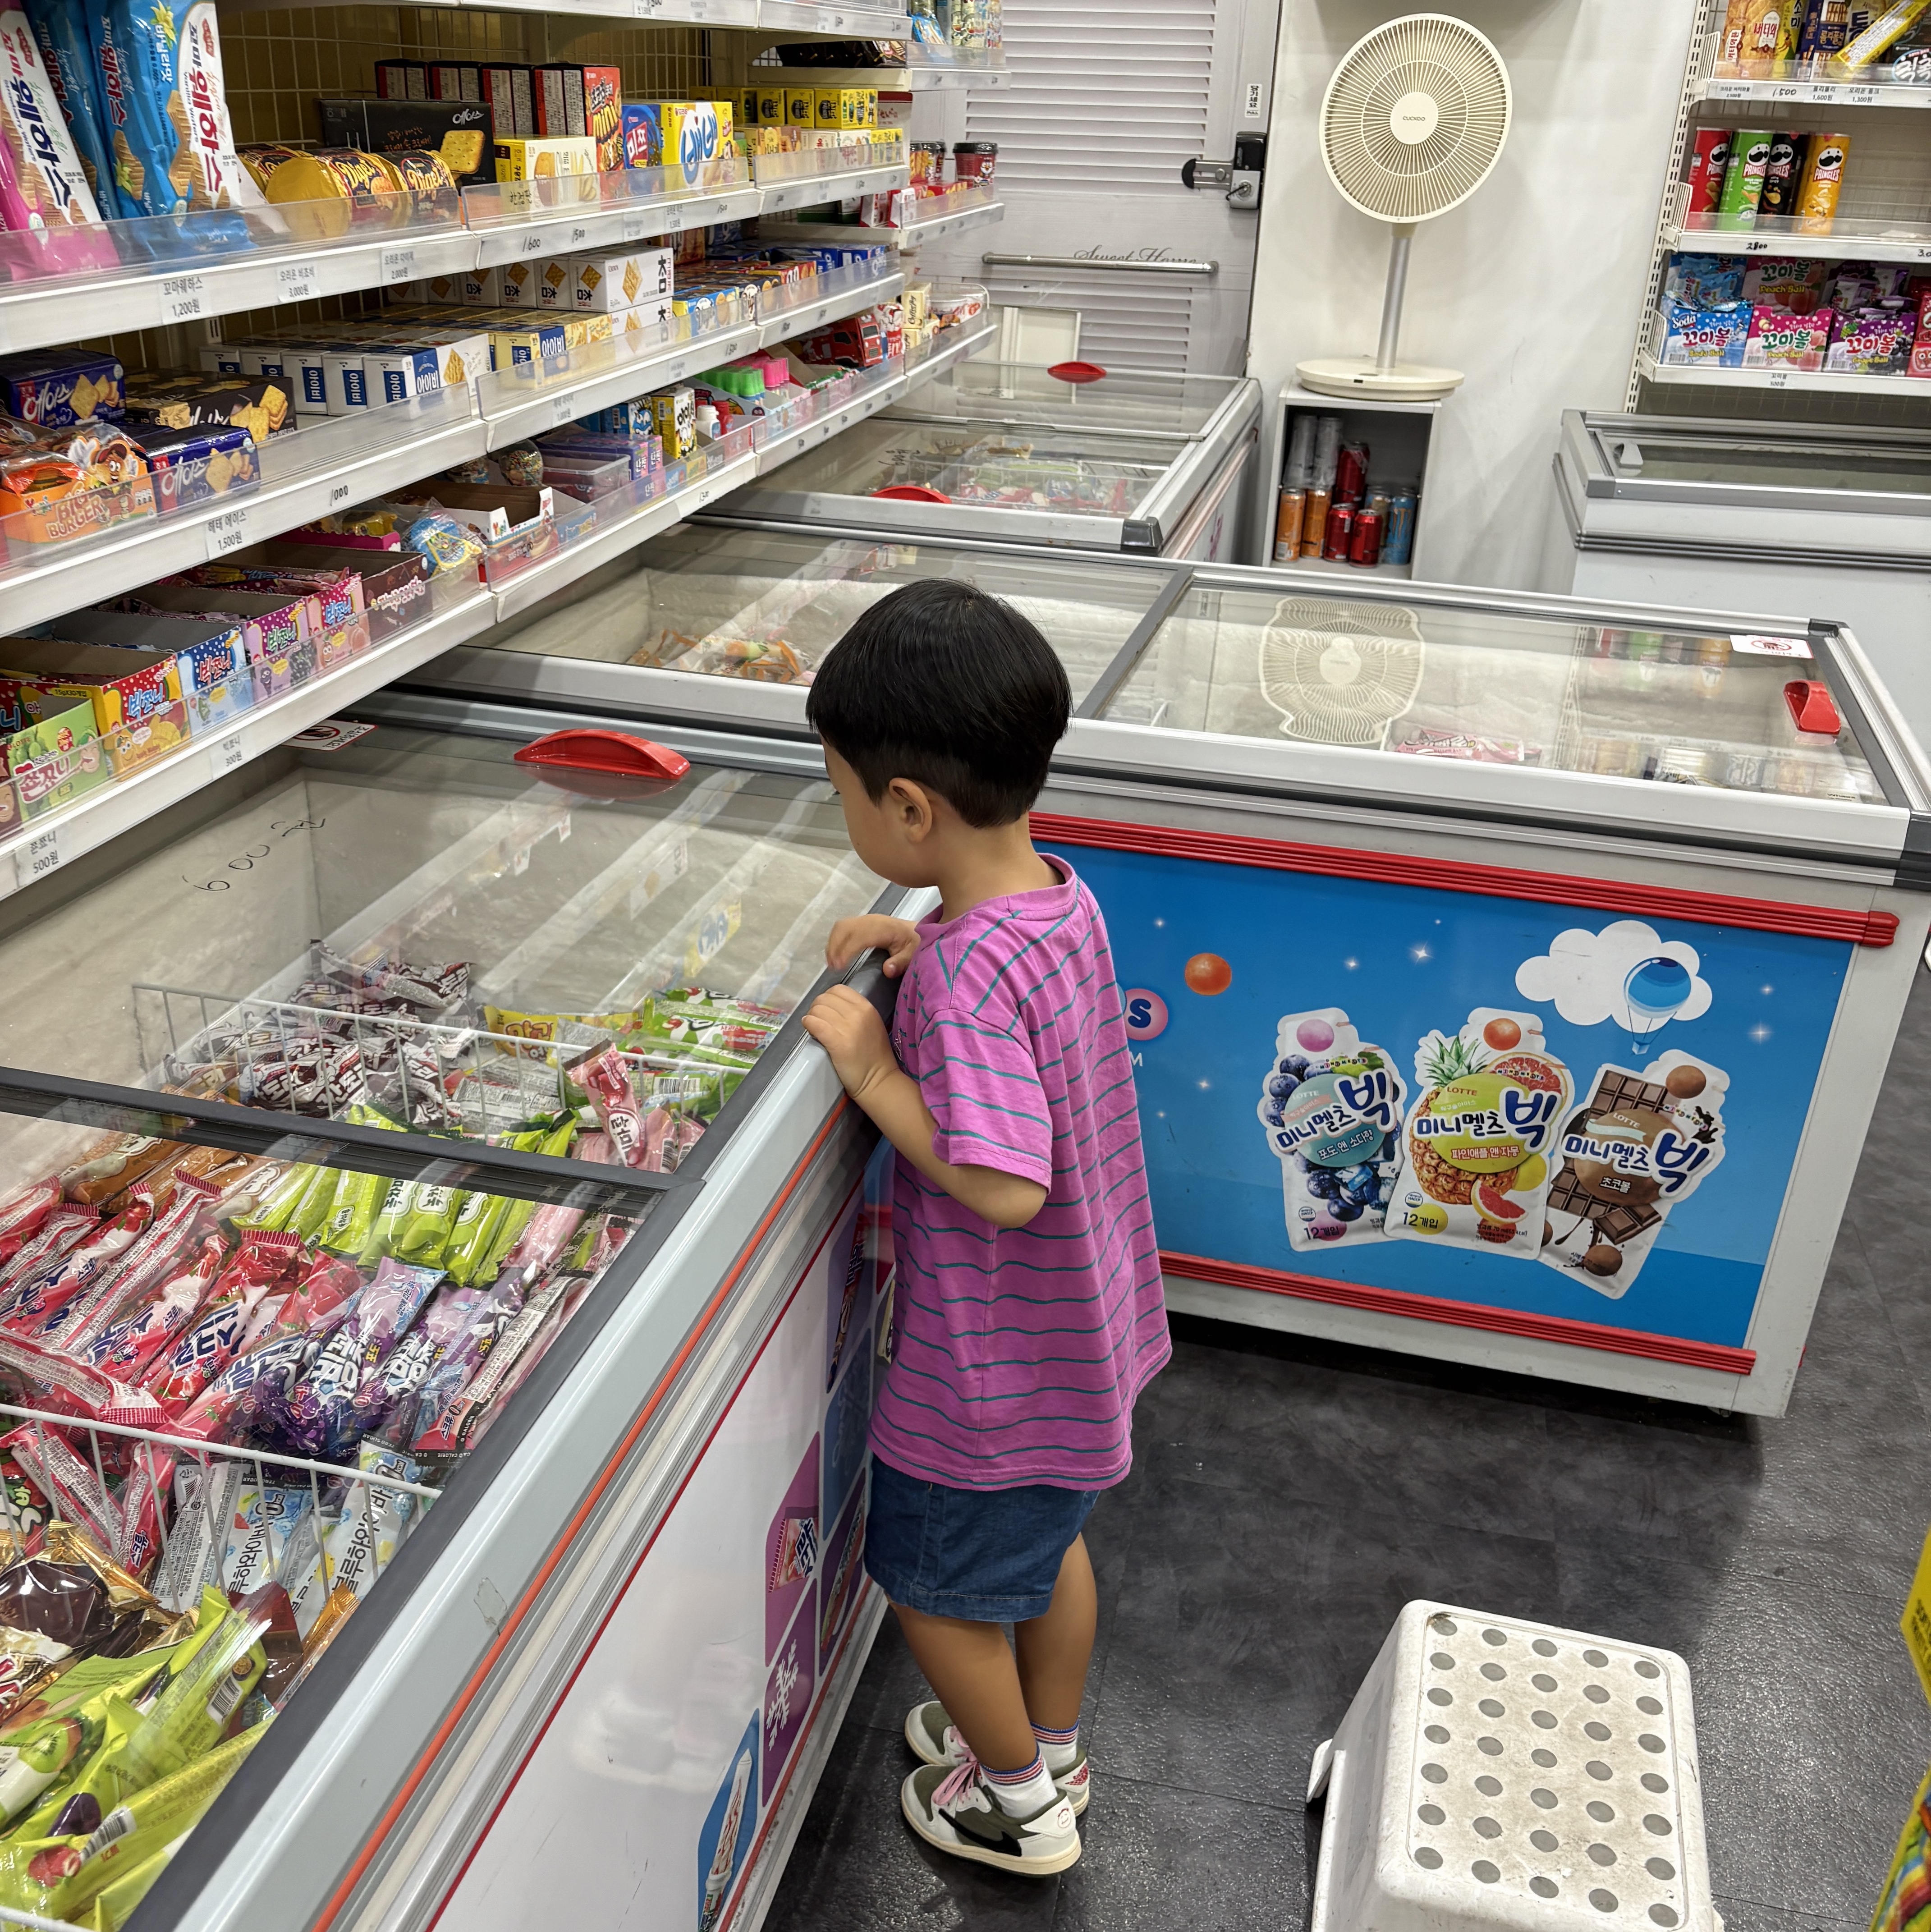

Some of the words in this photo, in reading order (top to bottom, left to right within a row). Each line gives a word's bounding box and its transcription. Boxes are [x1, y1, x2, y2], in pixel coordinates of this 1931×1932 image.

[188, 21, 220, 193] 꼬마웨하스
[1248, 85, 1259, 108] 당기세요
[1812, 94, 1833, 102] 1,600원
[0, 28, 70, 208] 꼬마웨하스
[1814, 168, 1840, 182] PRINGLES
[523, 239, 541, 252] 1600
[1761, 261, 1811, 283] 꼬미볼
[164, 277, 203, 295] 꼬마웨하스
[1759, 285, 1785, 294] Peach
[1788, 285, 1805, 294] Ball
[172, 299, 200, 317] 1,200원
[1672, 315, 1697, 329] Soda
[1683, 327, 1732, 348] 꼬미볼
[1761, 330, 1812, 350] 꼬미볼
[1845, 334, 1896, 355] 꼬미볼
[56, 490, 91, 523] BIG
[46, 496, 105, 539] BURGER
[225, 511, 247, 527] 에이스
[217, 529, 243, 551] 1,500원
[33, 849, 59, 874] 500원
[1128, 998, 1151, 1028] S
[1292, 1090, 1319, 1099] LOTTE
[1338, 1071, 1390, 1126] 빅
[1447, 1086, 1477, 1097] LOTTE
[1276, 1105, 1357, 1148] 미니멜츠
[1417, 1111, 1507, 1137] 미니멜츠
[1505, 1090, 1558, 1148] 빅
[1613, 1111, 1641, 1129] LOTTE
[1317, 1145, 1339, 1160] 포도
[1337, 1141, 1349, 1152] 앤
[1349, 1128, 1374, 1148] 소다향
[1451, 1147, 1488, 1160] 파인애플
[1489, 1147, 1500, 1158] 앤
[1501, 1146, 1520, 1158] 자몽
[1565, 1136, 1650, 1172] 미니멜츠
[1655, 1133, 1710, 1193] 빅
[1600, 1176, 1632, 1194] 초코볼
[1403, 1212, 1439, 1230] 12개입
[1303, 1225, 1341, 1241] 12개입
[365, 1344, 381, 1363] 포도
